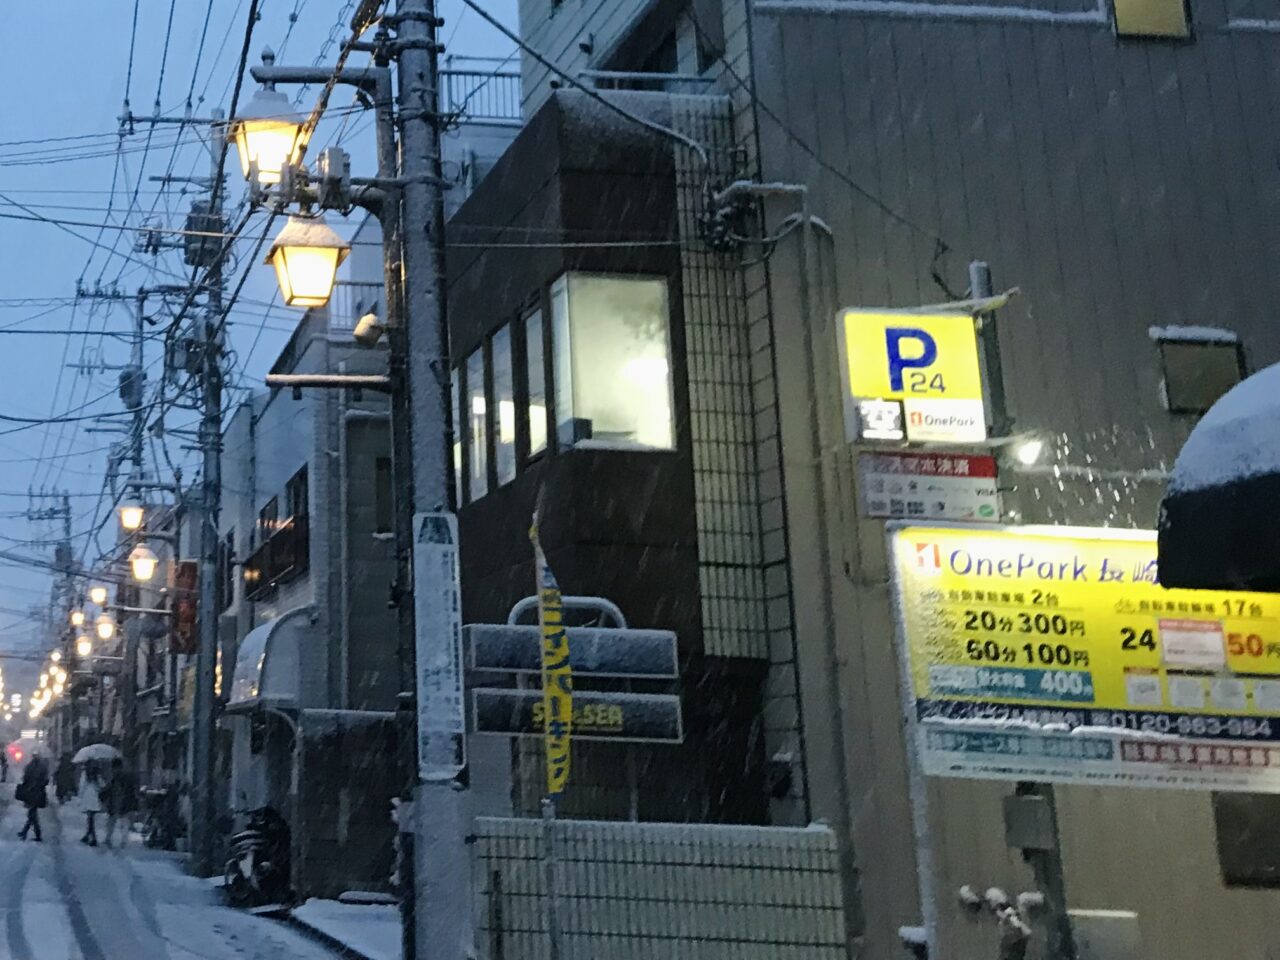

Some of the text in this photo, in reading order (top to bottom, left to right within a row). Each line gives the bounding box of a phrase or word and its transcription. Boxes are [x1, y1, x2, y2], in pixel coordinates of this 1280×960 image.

[885, 327, 946, 393] P 24
[924, 414, 975, 427] OnePark
[950, 549, 1088, 582] OnePark
[1120, 627, 1156, 651] 24
